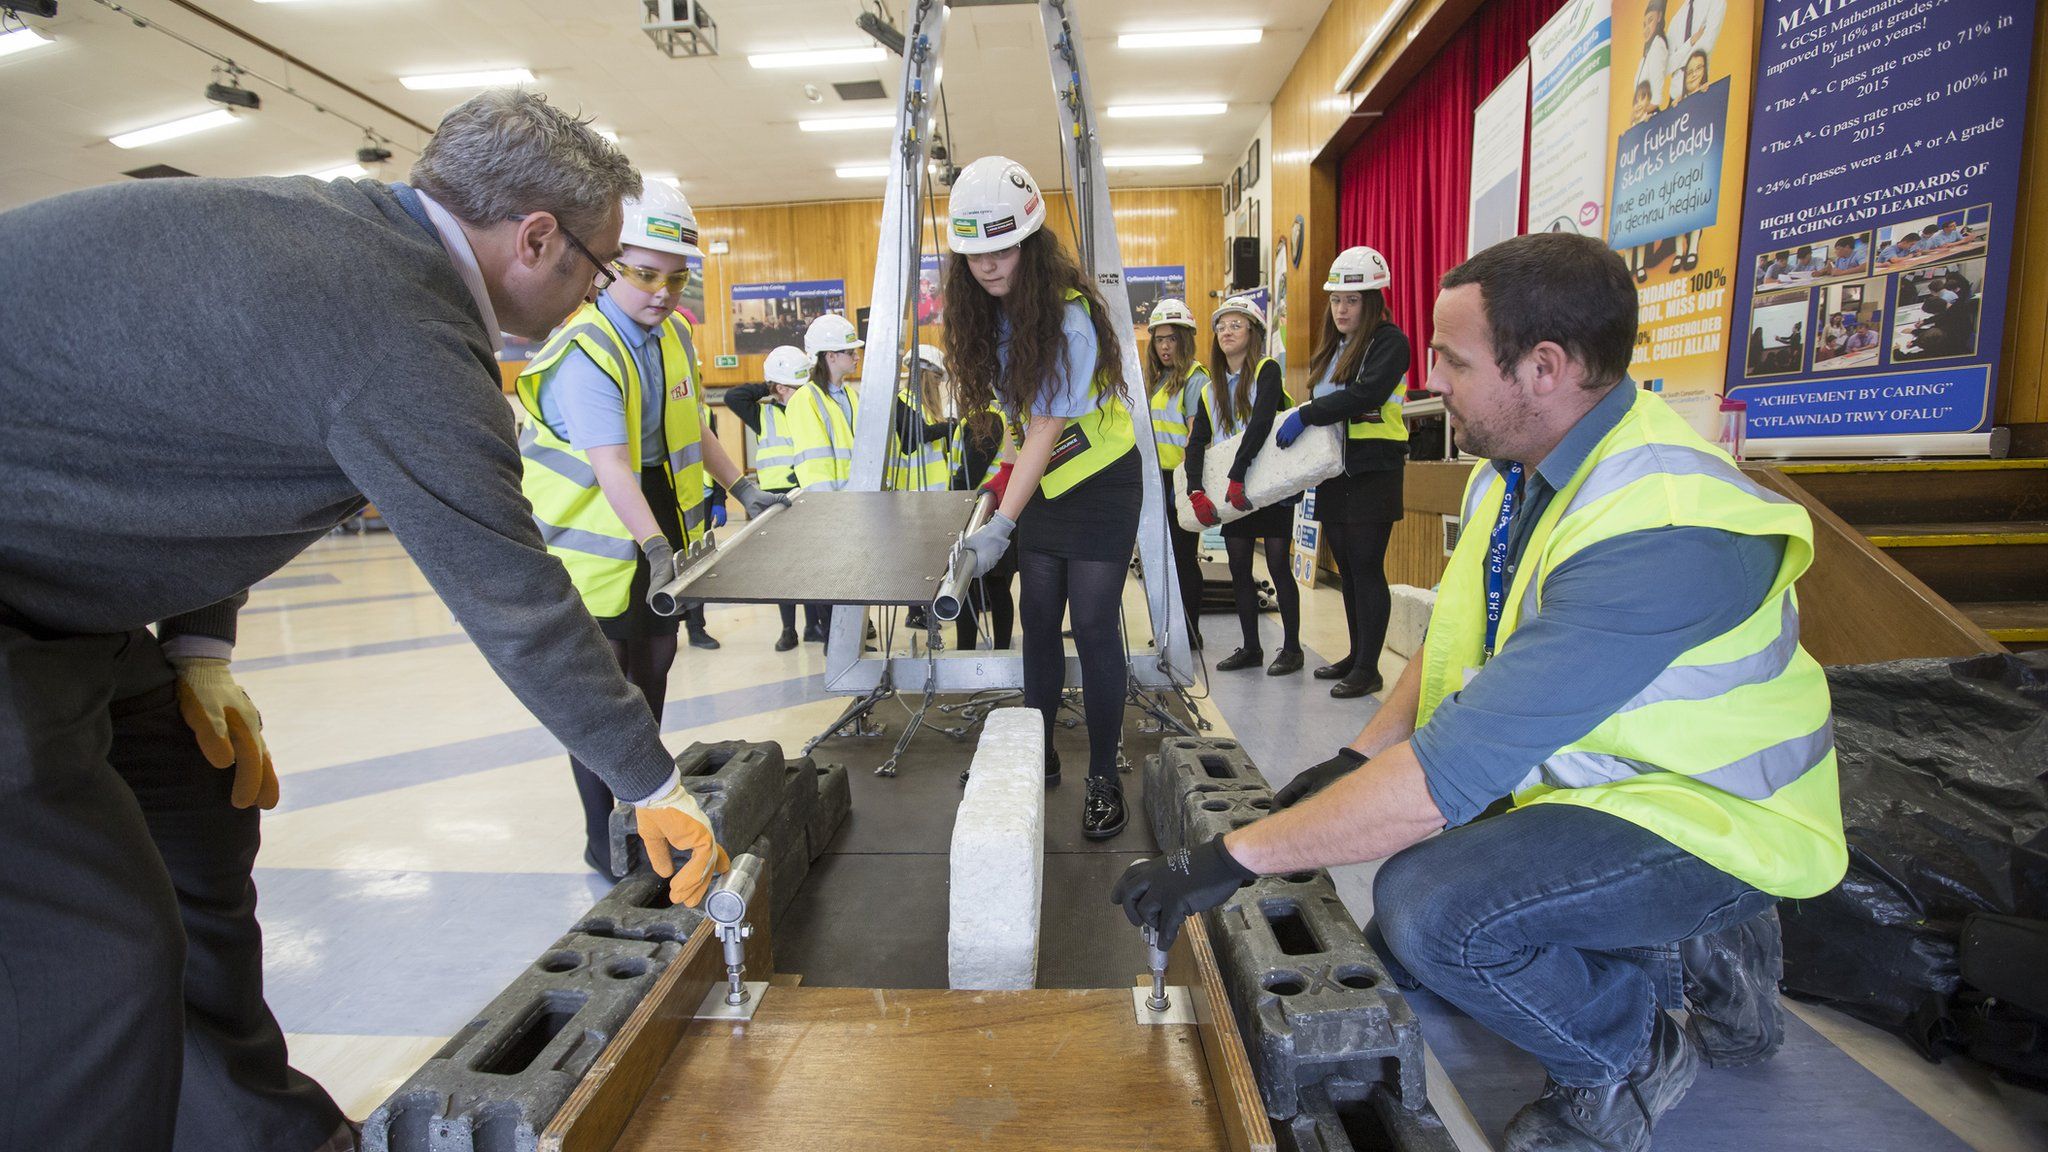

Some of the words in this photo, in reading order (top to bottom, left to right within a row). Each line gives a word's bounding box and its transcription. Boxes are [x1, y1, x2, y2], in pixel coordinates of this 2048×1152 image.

[1766, 45, 1819, 77] improved
[1822, 40, 1838, 53] by
[1842, 25, 1868, 45] 16%
[1871, 19, 1883, 32] at
[1887, 0, 1932, 28] grades
[1790, 25, 1827, 49] GCSE
[1830, 48, 1854, 68] just
[1857, 38, 1880, 54] two
[1885, 17, 1927, 46] years!
[1774, 98, 1796, 112] The
[1826, 80, 1837, 93] C
[1840, 71, 1867, 91] pass
[1871, 59, 1897, 76] rate
[1901, 47, 1932, 66] rose
[1936, 40, 1951, 52] to
[1957, 20, 1991, 44] 71%
[1998, 15, 2013, 29] in
[1856, 76, 1889, 98] 2015
[1770, 140, 1792, 153] The
[1820, 125, 1831, 137] G
[1833, 117, 1860, 136] pass
[1863, 107, 1889, 123] rate
[1892, 97, 1922, 113] rose
[1926, 91, 1940, 102] to
[1946, 71, 1988, 96] 100%
[1993, 67, 2008, 80] in
[1852, 122, 1885, 143] 2015
[1620, 144, 1640, 168] our
[1644, 112, 1690, 156] future
[1621, 152, 1664, 190] starts
[1669, 123, 1714, 164] today
[1764, 179, 1791, 195] 24%
[1793, 173, 1809, 187] of
[1808, 164, 1847, 185] passes
[1850, 154, 1882, 169] were
[1885, 149, 1898, 160] at
[1926, 137, 1943, 148] or
[1945, 130, 1957, 144] A
[1961, 117, 2004, 142] grade
[1615, 199, 1635, 217] mae
[1638, 188, 1655, 207] ein
[1658, 162, 1704, 205] dyfodol
[1760, 209, 1794, 230] HIGH
[1797, 194, 1863, 221] QUALITY
[1863, 168, 1960, 205] STANDARDS
[1964, 161, 1990, 178] OF
[1771, 214, 1843, 241] TEACHING
[1845, 206, 1877, 223] AND
[1881, 184, 1970, 216] LEARNING
[1612, 219, 1622, 246] yn
[1625, 207, 1665, 234] dechrau
[1668, 188, 1712, 216] heddiw
[1638, 277, 1688, 305] ENDANCE
[1691, 268, 1726, 292] 100%
[1638, 304, 1663, 325] OOL,
[1666, 295, 1695, 318] MISS
[1698, 288, 1725, 311] OUT
[1631, 345, 1651, 364] GOL,
[1653, 340, 1683, 360] COLLI
[1684, 333, 1721, 355] ALLAN
[1636, 331, 1650, 345] 0%
[1750, 412, 1842, 428] “CYFLAWNIAD
[1845, 410, 1888, 422] TRWY
[1890, 407, 1953, 421] OFALU”
[1754, 390, 1856, 407] “ACHIEVEMENT
[1859, 388, 1880, 400] BY
[1882, 382, 1954, 398] CARING”
[1489, 592, 1500, 621] C.H.S
